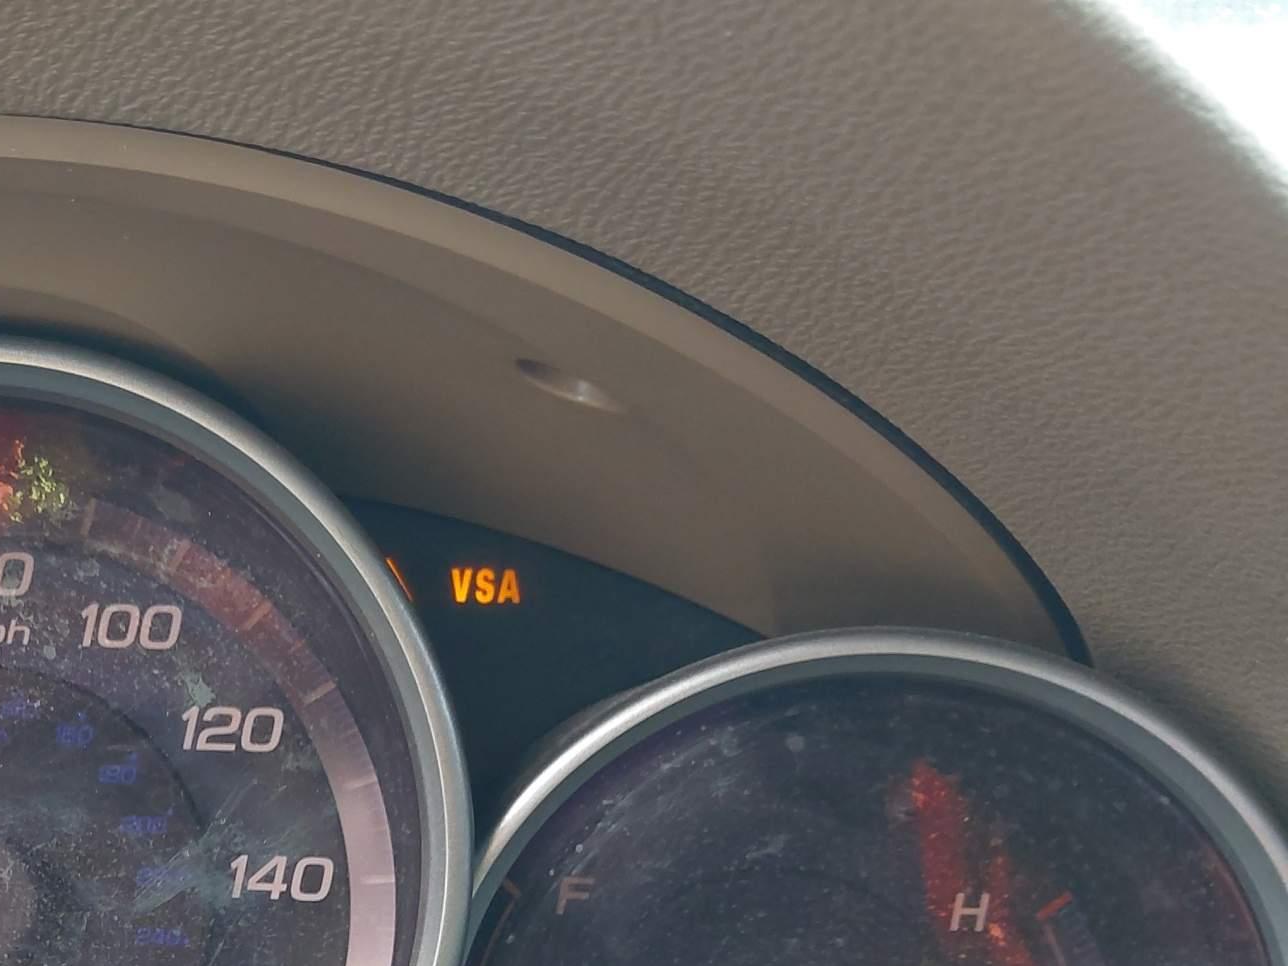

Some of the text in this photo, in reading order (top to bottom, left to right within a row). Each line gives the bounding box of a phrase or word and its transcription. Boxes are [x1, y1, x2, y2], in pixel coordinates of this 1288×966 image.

[450, 567, 521, 605] VSA
[81, 602, 182, 650] 100
[182, 706, 284, 752] 120
[230, 855, 334, 902] 140
[555, 877, 596, 915] F
[950, 892, 991, 932] H
